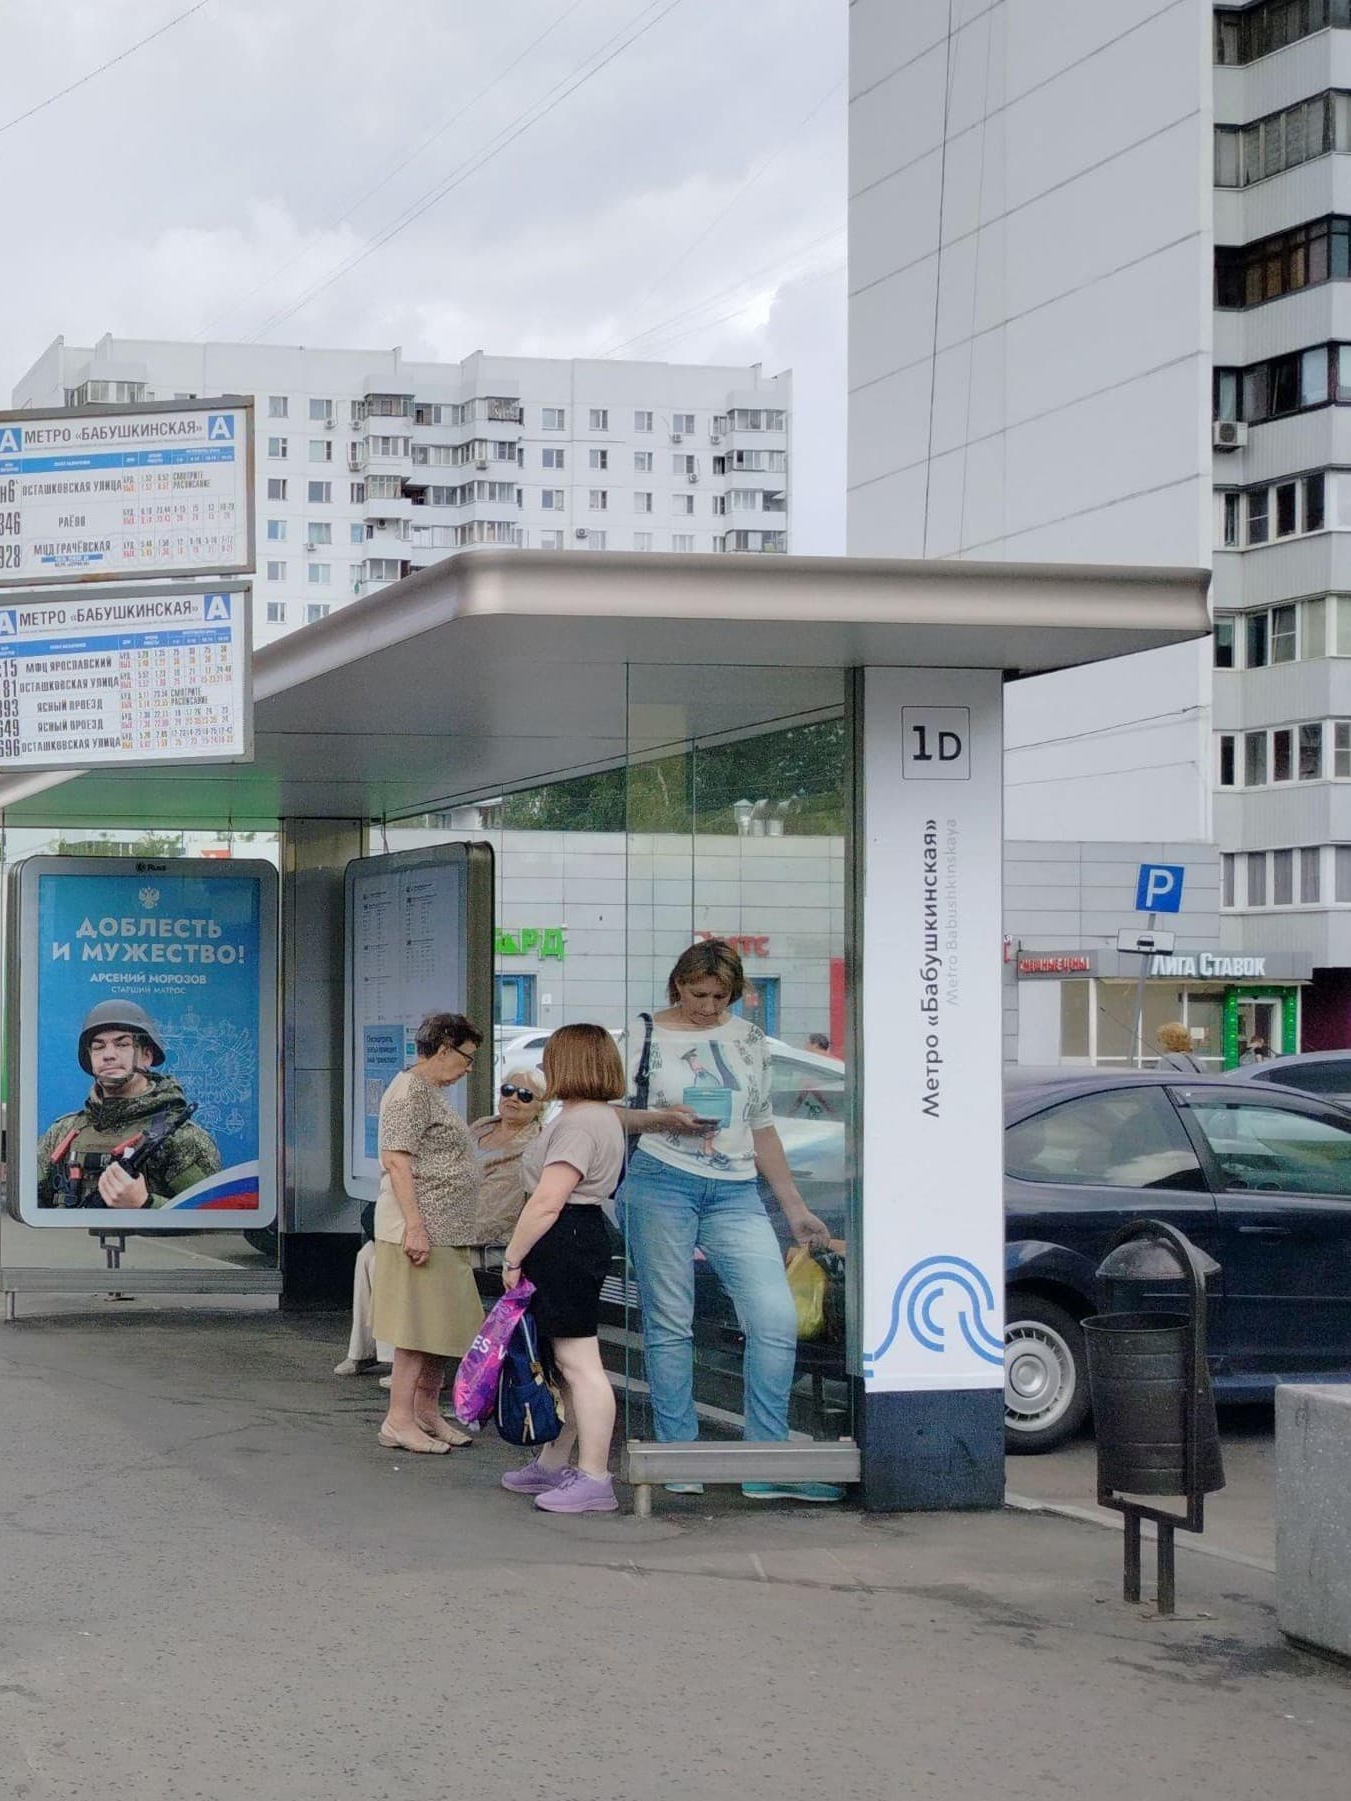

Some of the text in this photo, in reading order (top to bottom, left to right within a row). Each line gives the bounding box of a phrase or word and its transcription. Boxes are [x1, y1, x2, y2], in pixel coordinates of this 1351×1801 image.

[24, 428, 71, 444] МЕТРО
[75, 421, 203, 442] «БАБУШКИНСКАЯ»
[23, 481, 90, 497] ОСТАШКОВСКАЯ
[93, 480, 122, 492] УЛИЦА
[57, 540, 111, 554] ГРАЧЁВСКАЯ
[19, 610, 66, 627] МЕТРО
[70, 600, 198, 623] «БАБУШКИНСКАЯ»
[26, 662, 48, 673] МФЦ
[50, 657, 112, 672] ЯРОСЛАВСКИЙ
[20, 680, 88, 693] ОСТАШКОВСКАЯ
[91, 677, 120, 688] УЛИЦА
[37, 700, 67, 713] ЯСНЫЙ
[70, 699, 103, 711] ПРОЕЗД
[38, 719, 67, 732] ЯСНЫЙ
[70, 718, 104, 731] ПРОЕЗД
[22, 739, 89, 753] ОСТАШКОВСКАЯ
[92, 737, 121, 749] УЛИЦА
[912, 726, 962, 761] 1D
[1146, 869, 1174, 907] P
[76, 917, 222, 938] ДОБЛЕСТЬ
[51, 942, 245, 964] И МУЖЕСТВО!
[920, 819, 942, 1118] Метро «Бабушкинская»
[90, 972, 207, 985] АРСЕНИЙ МОРОЗОВ
[946, 954, 959, 1006] Metro
